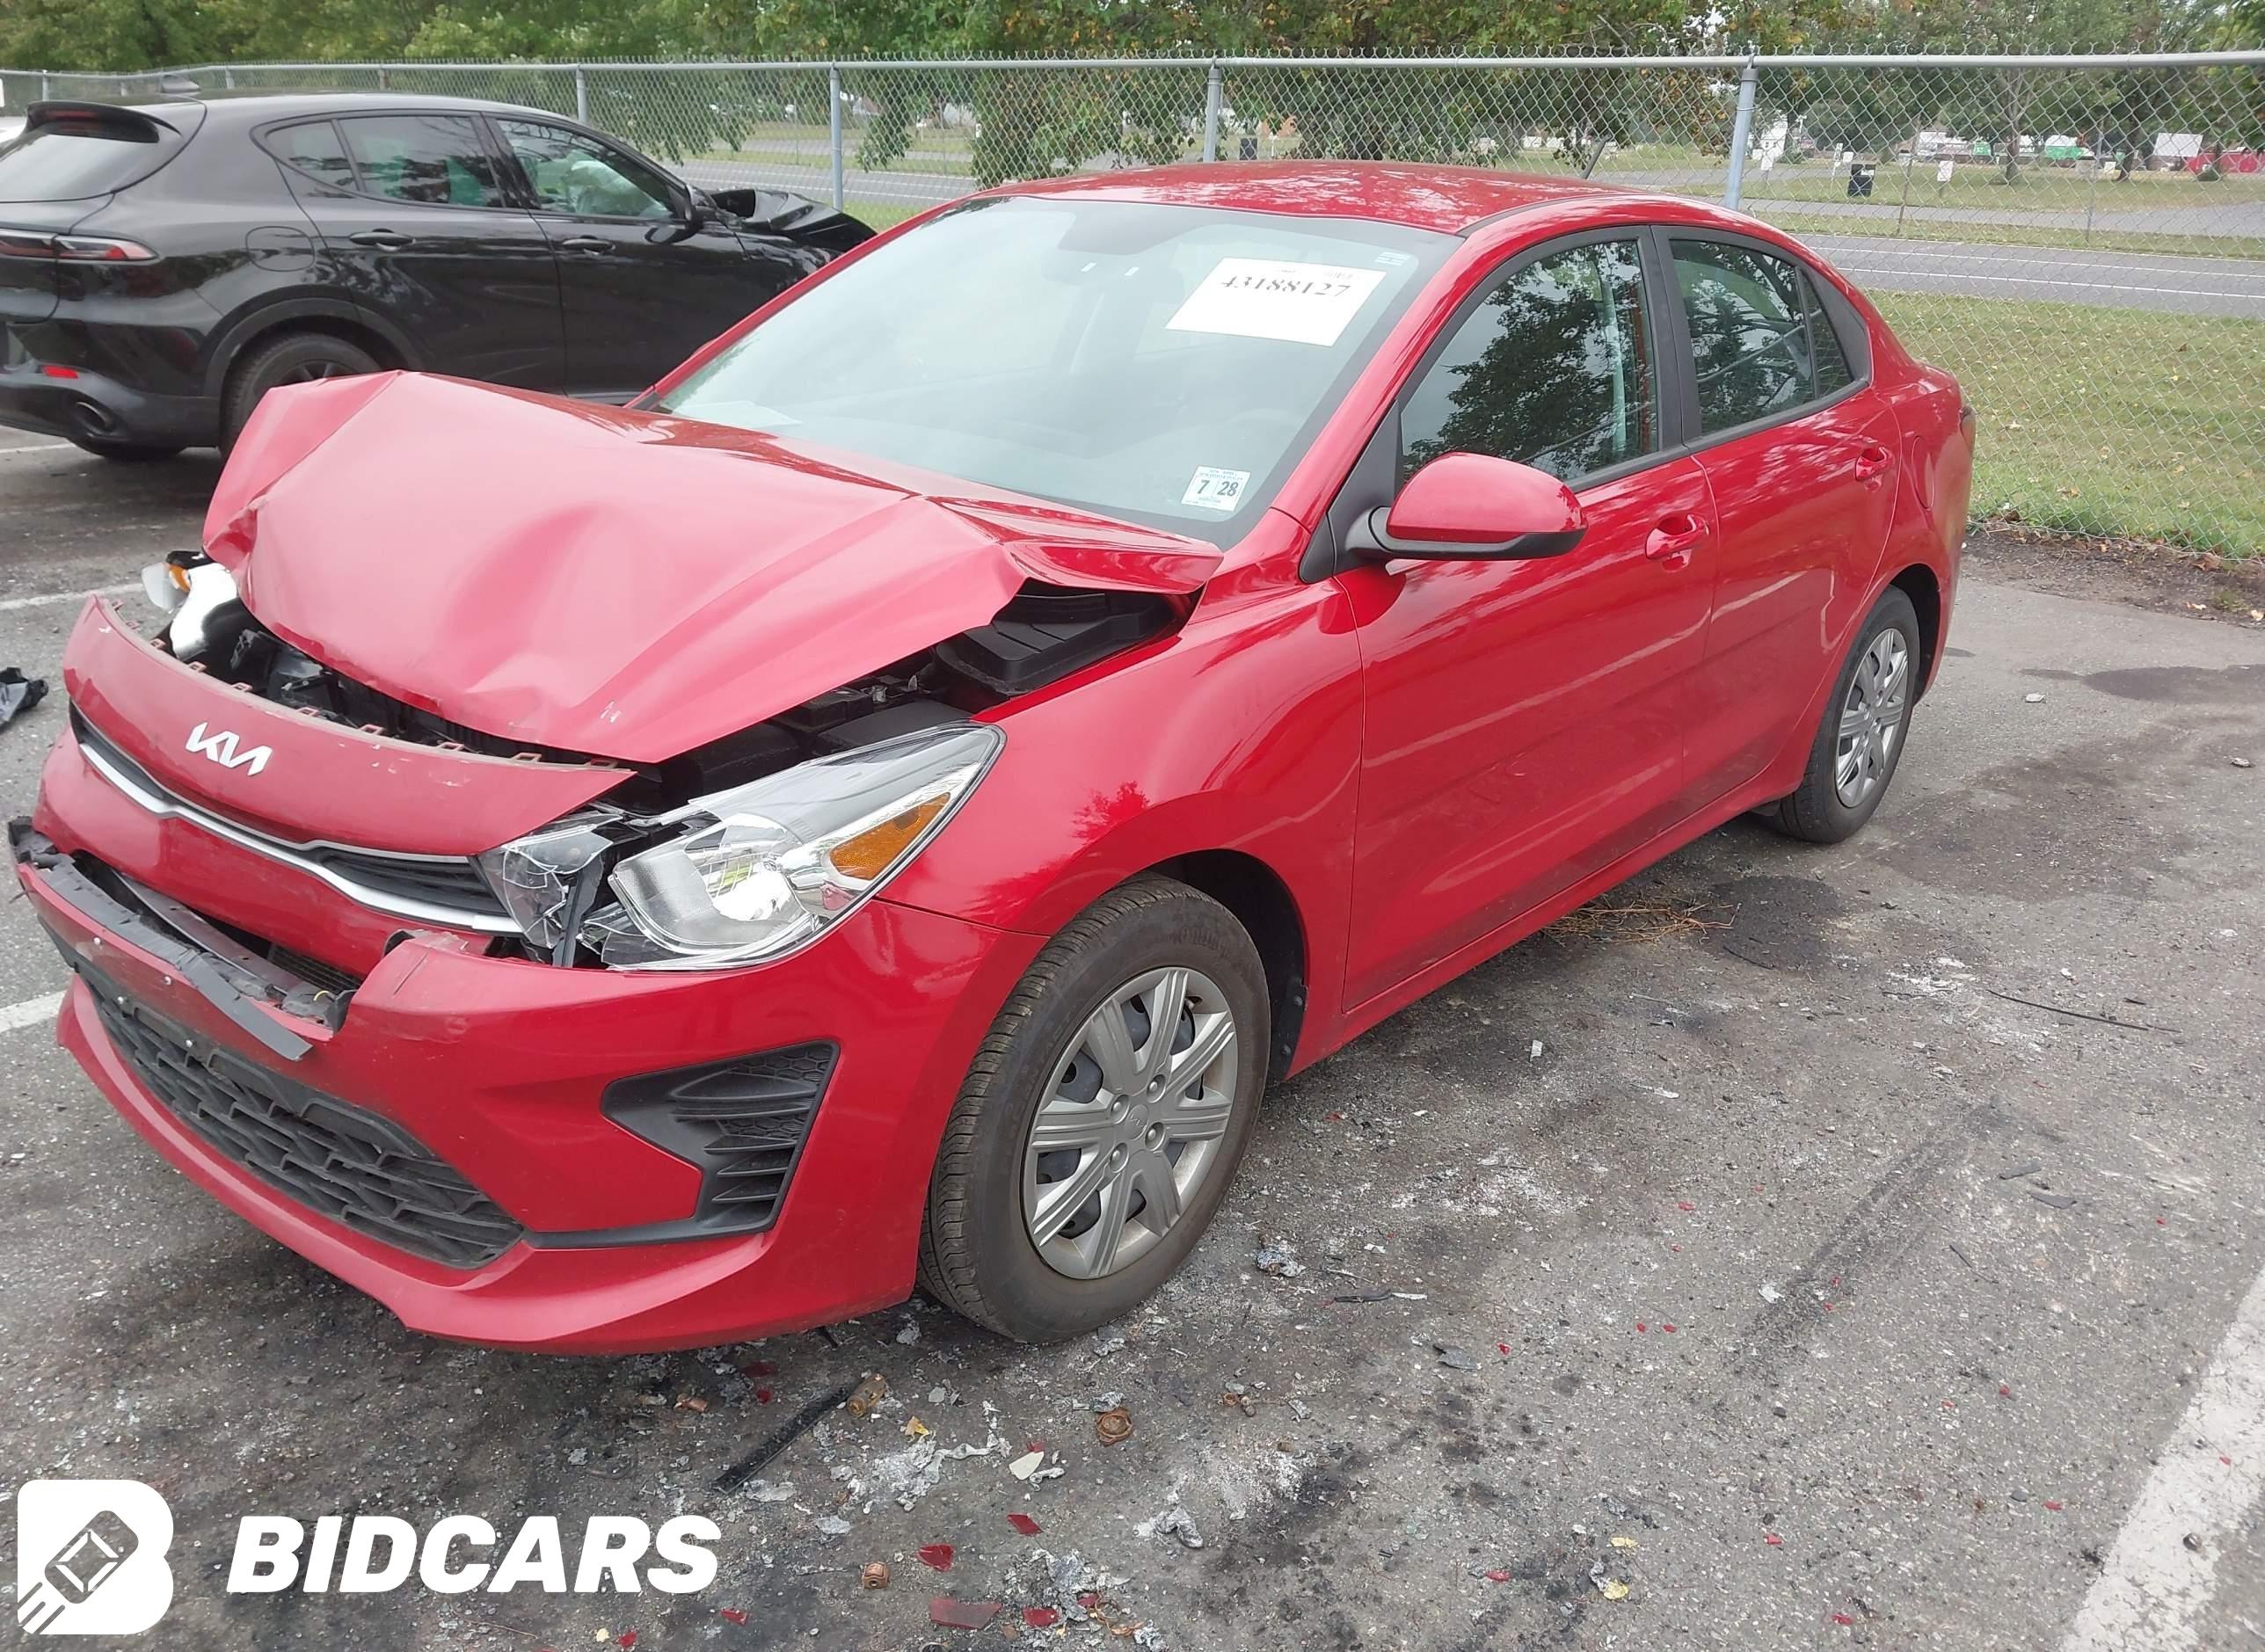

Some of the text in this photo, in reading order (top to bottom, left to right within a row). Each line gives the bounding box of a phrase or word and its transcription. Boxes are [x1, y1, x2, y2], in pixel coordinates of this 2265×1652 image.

[1221, 276, 1351, 297] 43188127
[1197, 479, 1239, 497] 7 28
[185, 722, 273, 776] KIA
